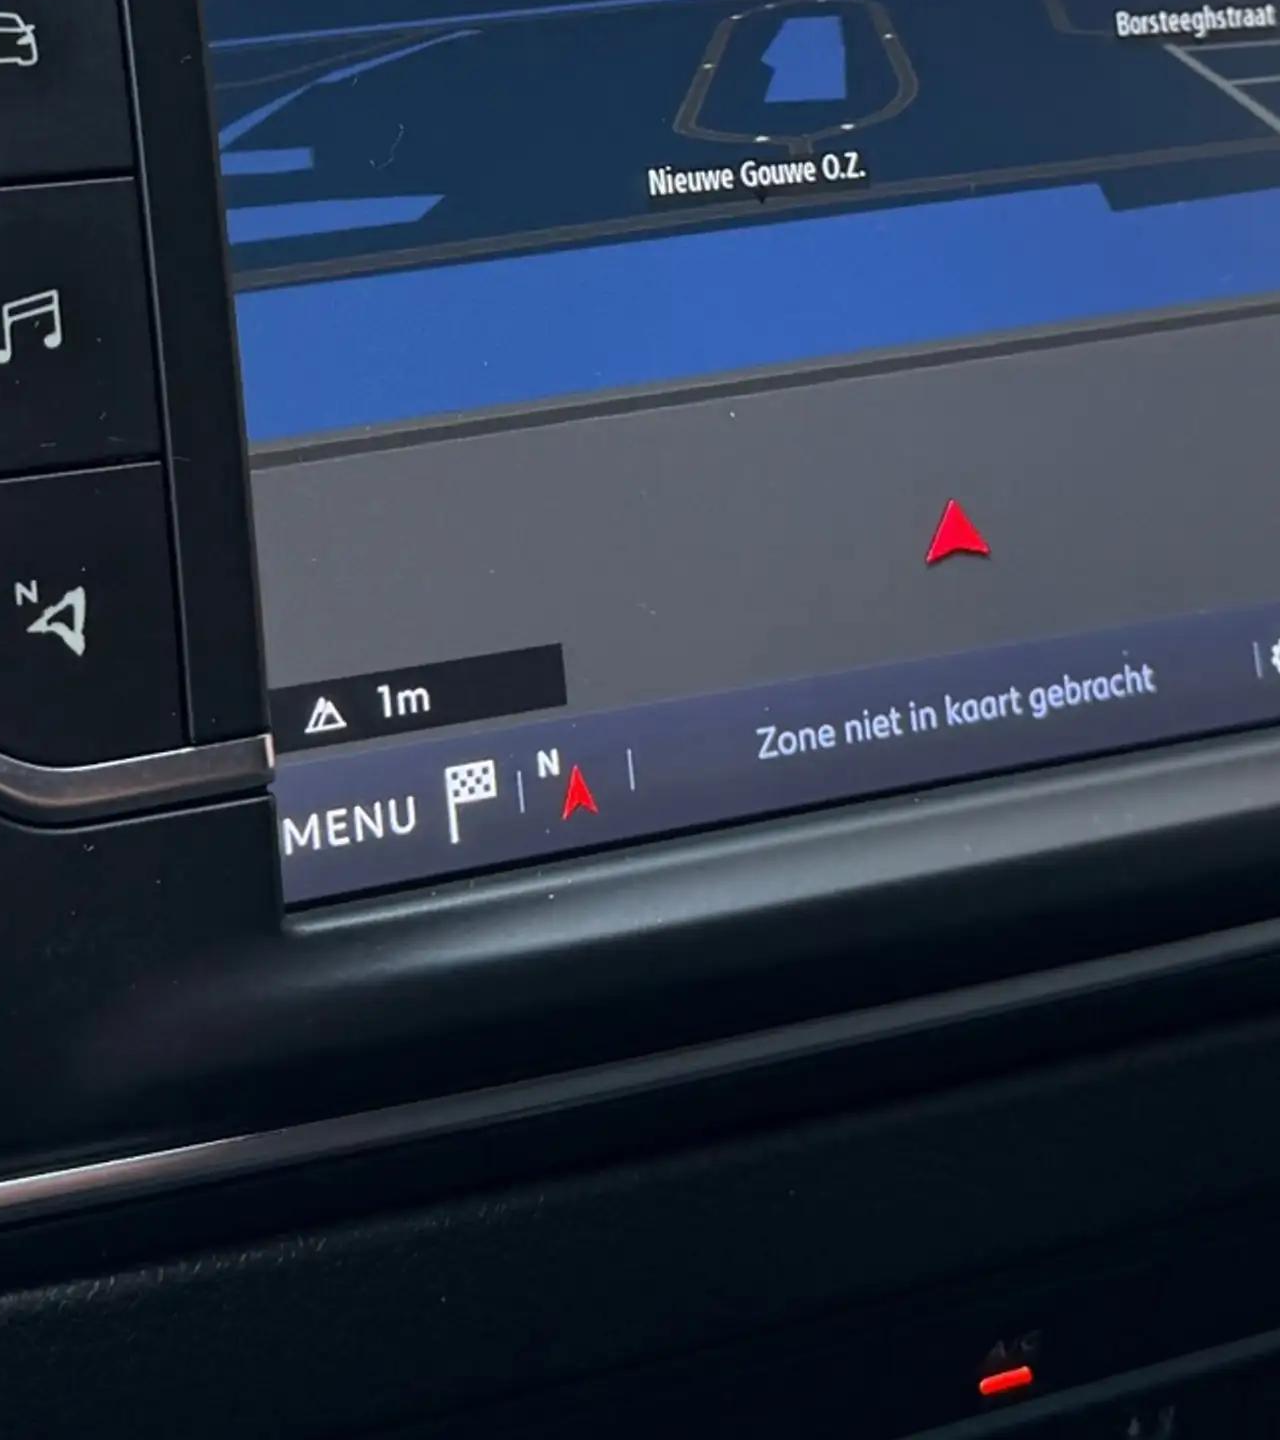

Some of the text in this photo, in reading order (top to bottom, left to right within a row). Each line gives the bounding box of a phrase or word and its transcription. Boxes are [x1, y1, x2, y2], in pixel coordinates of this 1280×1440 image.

[1115, 2, 1277, 40] Borsteeghstraat
[648, 153, 866, 198] Nieuwe Gouwe O.Z.
[15, 579, 39, 607] N
[376, 683, 431, 719] 1m
[756, 662, 1156, 760] Zone niet in kaart gebracht
[536, 748, 561, 778] N
[282, 795, 418, 856] MENU
